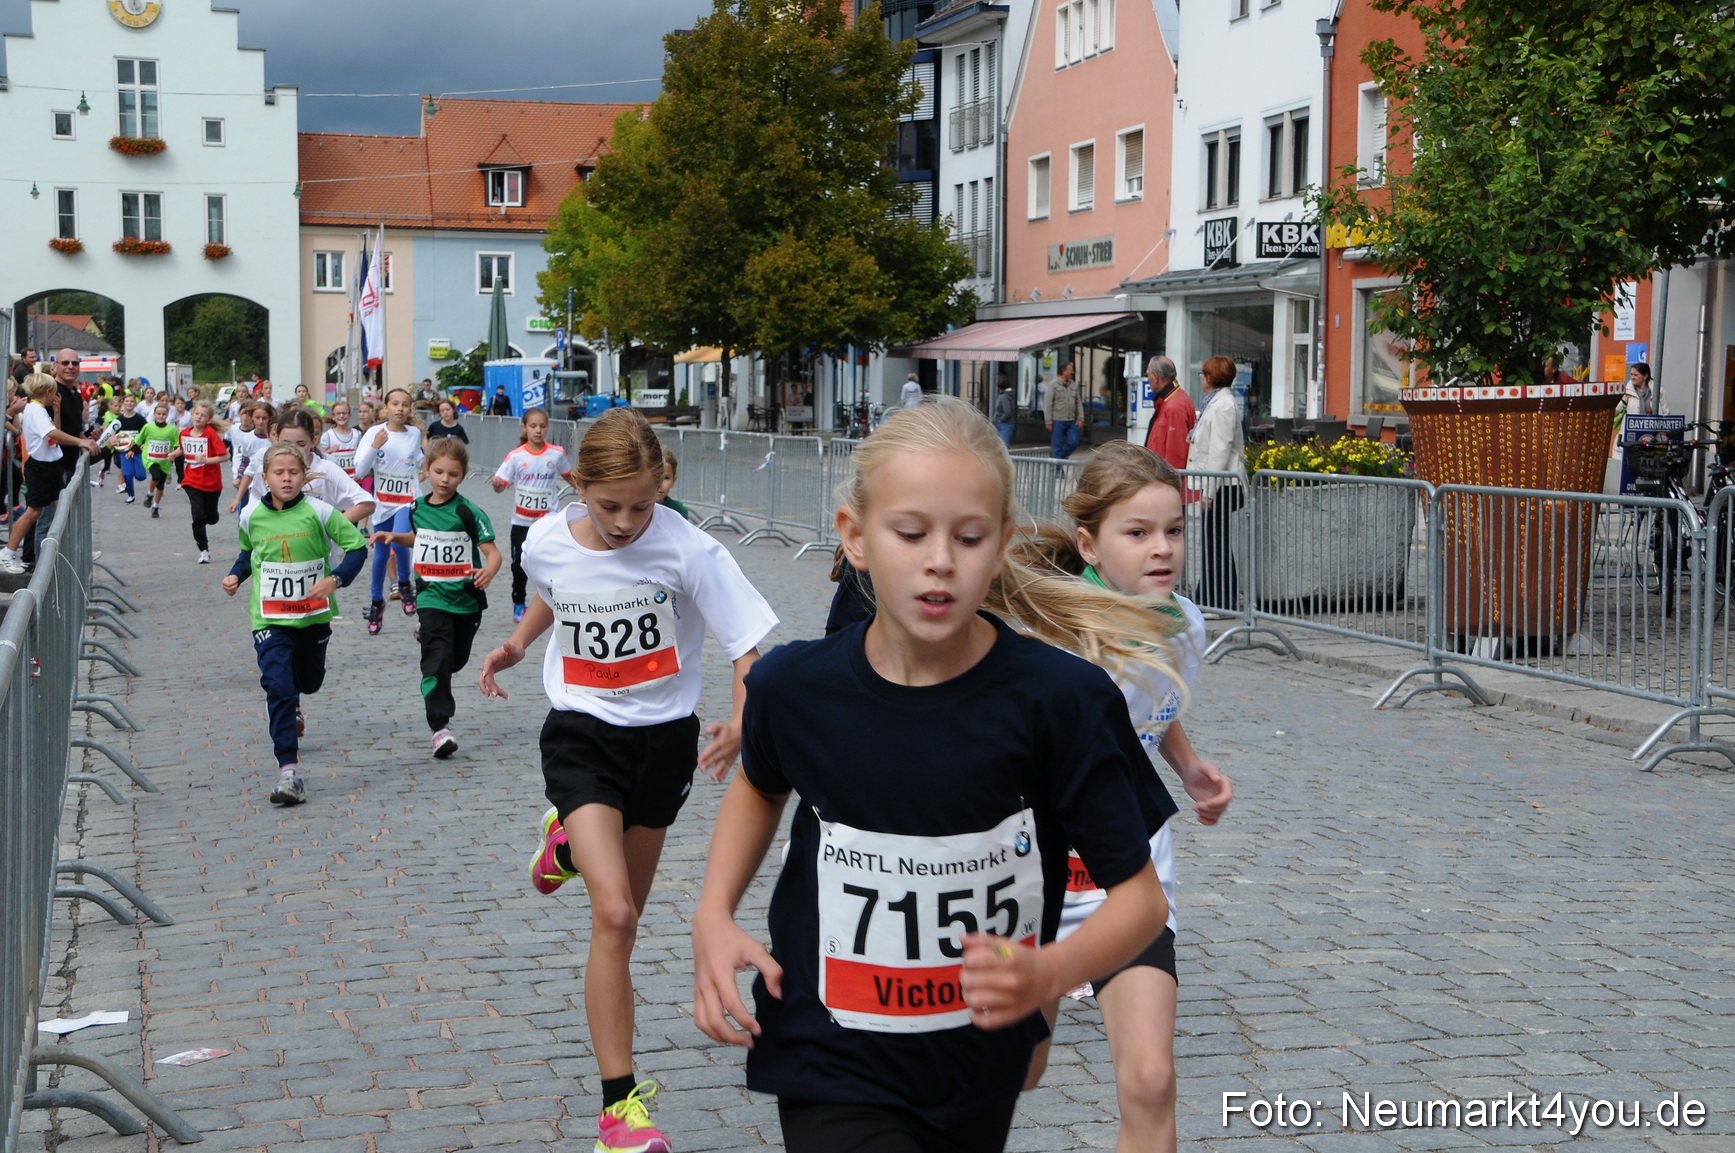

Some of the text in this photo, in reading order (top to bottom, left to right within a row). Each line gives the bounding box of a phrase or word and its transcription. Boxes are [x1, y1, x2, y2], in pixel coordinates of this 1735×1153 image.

[1207, 220, 1231, 247] KBK
[1262, 224, 1320, 244] KBK
[557, 331, 563, 348] P
[1629, 419, 1682, 430] BAYERNPARTEI
[380, 478, 410, 493] 7001
[519, 494, 548, 509] 7215
[420, 544, 465, 563] 7182
[262, 566, 315, 575] PARTL Neumarkt
[421, 566, 464, 575] Cassandra
[268, 573, 318, 598] 7017
[281, 602, 312, 612] Janika
[588, 596, 650, 614] Neumarkt
[561, 612, 662, 660] 7328
[584, 663, 621, 680] Paula
[823, 843, 1008, 876] PARTL Neumarkt
[842, 875, 1020, 961] 7155
